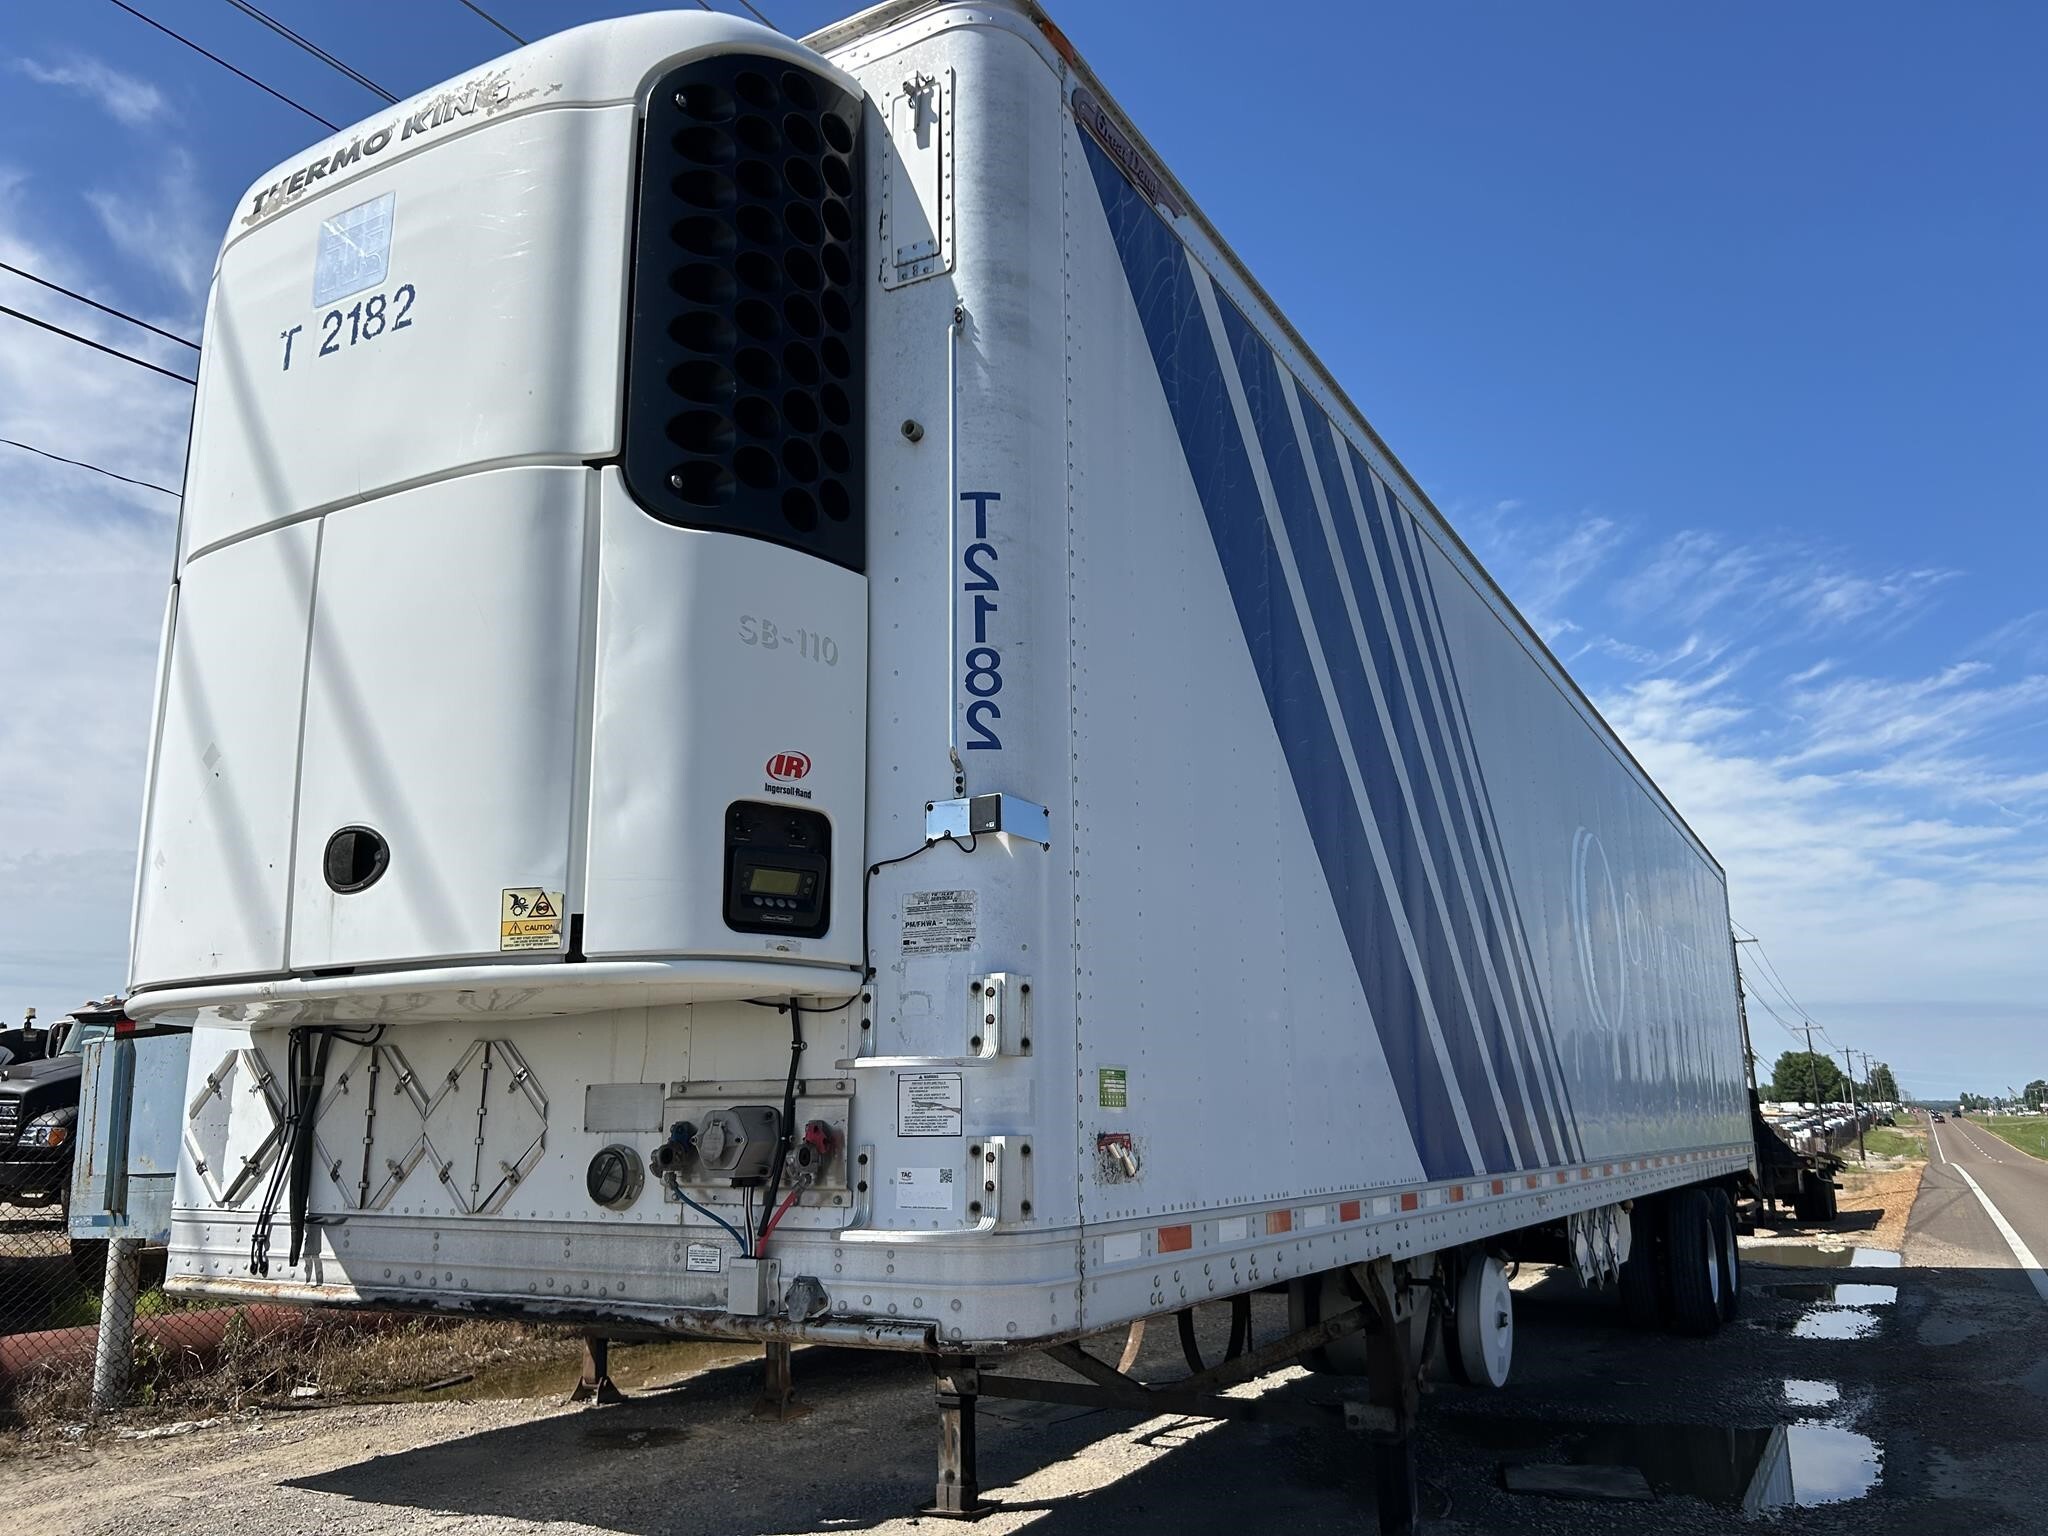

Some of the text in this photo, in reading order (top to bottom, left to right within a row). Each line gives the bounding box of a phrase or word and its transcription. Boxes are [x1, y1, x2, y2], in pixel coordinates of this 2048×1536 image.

[401, 80, 511, 141] KING
[319, 284, 415, 357] 2182
[738, 615, 838, 666] SB-110
[774, 754, 804, 778] IR
[524, 923, 554, 932] CAUTIO
